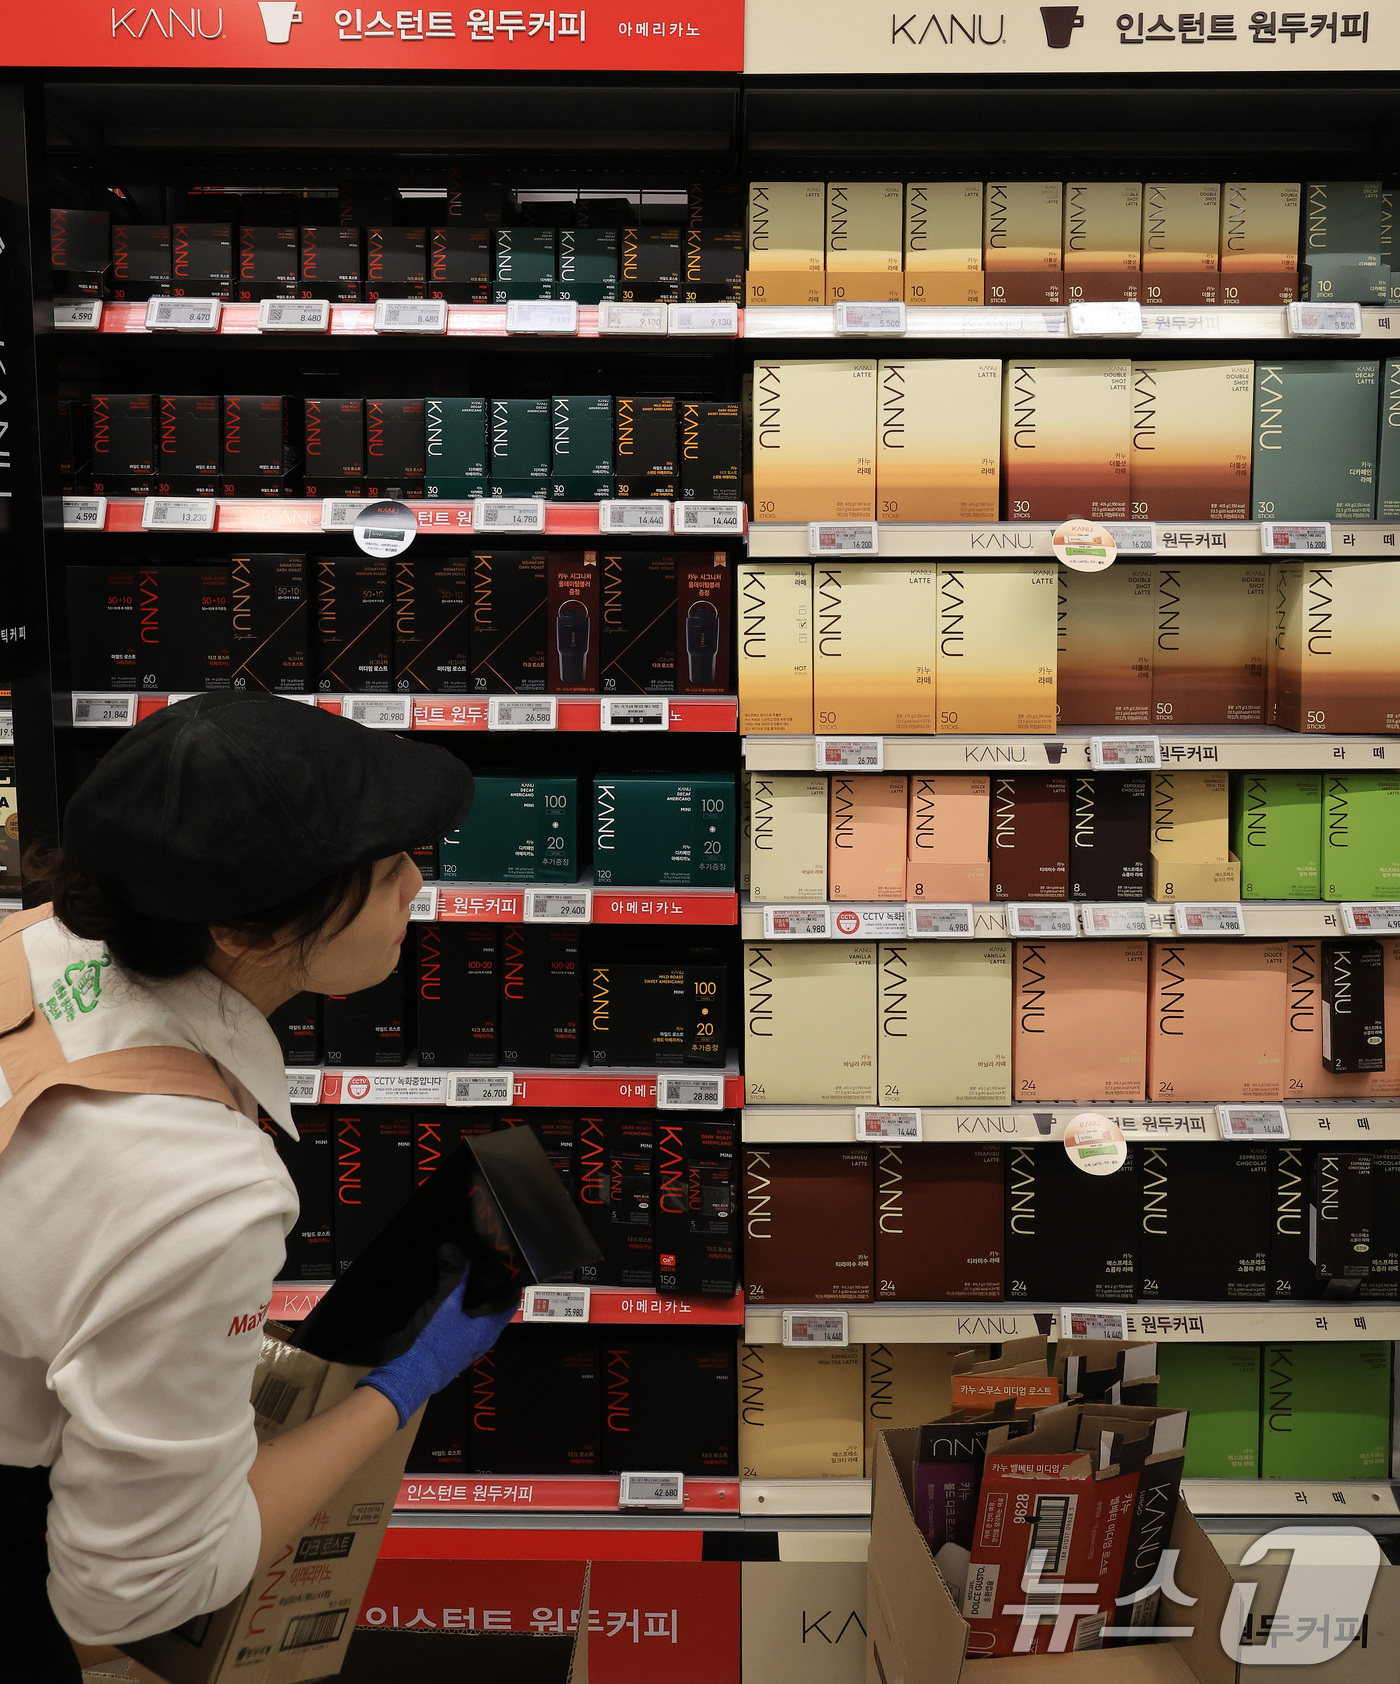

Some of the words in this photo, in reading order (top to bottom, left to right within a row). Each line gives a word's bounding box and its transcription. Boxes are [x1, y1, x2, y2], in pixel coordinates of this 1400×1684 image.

[111, 7, 223, 39] KANU
[335, 9, 456, 41] 인스턴트
[467, 9, 586, 42] 원두커피
[619, 22, 700, 38] 아메리카노
[893, 14, 1004, 44] KANU
[1116, 12, 1237, 43] 인스턴트
[1249, 11, 1369, 43] 원두커피
[752, 287, 764, 296] 10
[991, 287, 1005, 297] 10
[1070, 287, 1083, 297] 10
[1319, 281, 1331, 291] 10
[115, 290, 125, 298] 30
[174, 289, 184, 297] 30
[759, 366, 780, 448] KANU
[883, 366, 905, 448] KANU
[1014, 366, 1035, 449] KANU
[1259, 367, 1283, 449] KANU
[857, 467, 871, 475] 라떼
[759, 501, 775, 512] 30
[1014, 501, 1030, 512] 30
[1258, 501, 1274, 512] 30
[972, 533, 1032, 548] KANU
[1162, 533, 1227, 549] 원두커피
[569, 588, 580, 596] 증정
[743, 572, 765, 658] KANU
[819, 570, 841, 656] KANU
[941, 570, 964, 657] KANU
[1157, 570, 1180, 650] KANU
[1308, 570, 1332, 655] KANU
[143, 674, 156, 684] 60
[234, 678, 245, 687] 60
[475, 678, 486, 687] 70
[604, 678, 615, 687] 70
[916, 676, 931, 685] 라떼
[1156, 703, 1173, 714] 50
[820, 712, 836, 723] 50
[1307, 711, 1325, 723] 50
[965, 747, 1026, 762] KANU
[544, 796, 567, 808] 100
[702, 799, 724, 812] 100
[597, 786, 615, 850] KANU
[547, 837, 564, 849] 20
[704, 841, 721, 854] 20
[542, 858, 569, 866] 추가증정
[699, 862, 726, 871] 추가증정
[444, 865, 457, 873] 120
[597, 870, 611, 879] 120
[915, 884, 923, 895] 8
[996, 884, 1002, 893] 8
[1165, 883, 1173, 894] 8
[1246, 884, 1253, 892] 8
[453, 897, 517, 915] 원두커피
[611, 901, 684, 914] 아메리카노
[863, 912, 884, 921] CCTV
[695, 982, 716, 995] 100
[749, 948, 772, 1036] KANU
[884, 948, 907, 1036] KANU
[1160, 948, 1185, 1035] KANU
[593, 969, 609, 1031] KANU
[697, 1023, 714, 1036] 20
[593, 1051, 606, 1059] 120
[374, 1077, 395, 1085] CCTV
[397, 1077, 441, 1086] 녹화중입니다
[1159, 1082, 1174, 1092] 24
[751, 1084, 765, 1095] 24
[957, 1117, 1016, 1133] KANU
[1142, 1117, 1206, 1133] 원두커피
[747, 1152, 771, 1238] KANU
[1010, 1147, 1035, 1235] KANU
[1143, 1147, 1167, 1235] KANU
[1276, 1147, 1301, 1235] KANU
[581, 1267, 596, 1275] 150
[660, 1276, 676, 1285] 150
[1143, 1280, 1159, 1290] 24
[750, 1285, 764, 1295] 24
[621, 1300, 691, 1313] 아메리카노
[958, 1317, 1017, 1334] KANU
[1142, 1316, 1204, 1334] 원두커피
[961, 1386, 976, 1394] 카누
[978, 1386, 1001, 1394] 스무스
[1004, 1387, 1026, 1396] 미디엄
[1029, 1387, 1051, 1395] 로스트
[744, 1467, 757, 1477] 24
[992, 1464, 1008, 1472] 카누
[1011, 1464, 1034, 1473] 벨베티
[1037, 1465, 1059, 1473] 미디엄
[407, 1485, 467, 1501] 인스턴트
[473, 1485, 533, 1502] 원두커피
[1014, 1494, 1029, 1523] 9628
[309, 1511, 330, 1530] 카누
[300, 1541, 320, 1558] 다크
[320, 1537, 351, 1554] 로스트
[290, 1564, 332, 1586] 아메리카노
[972, 1593, 981, 1615] DOLCE
